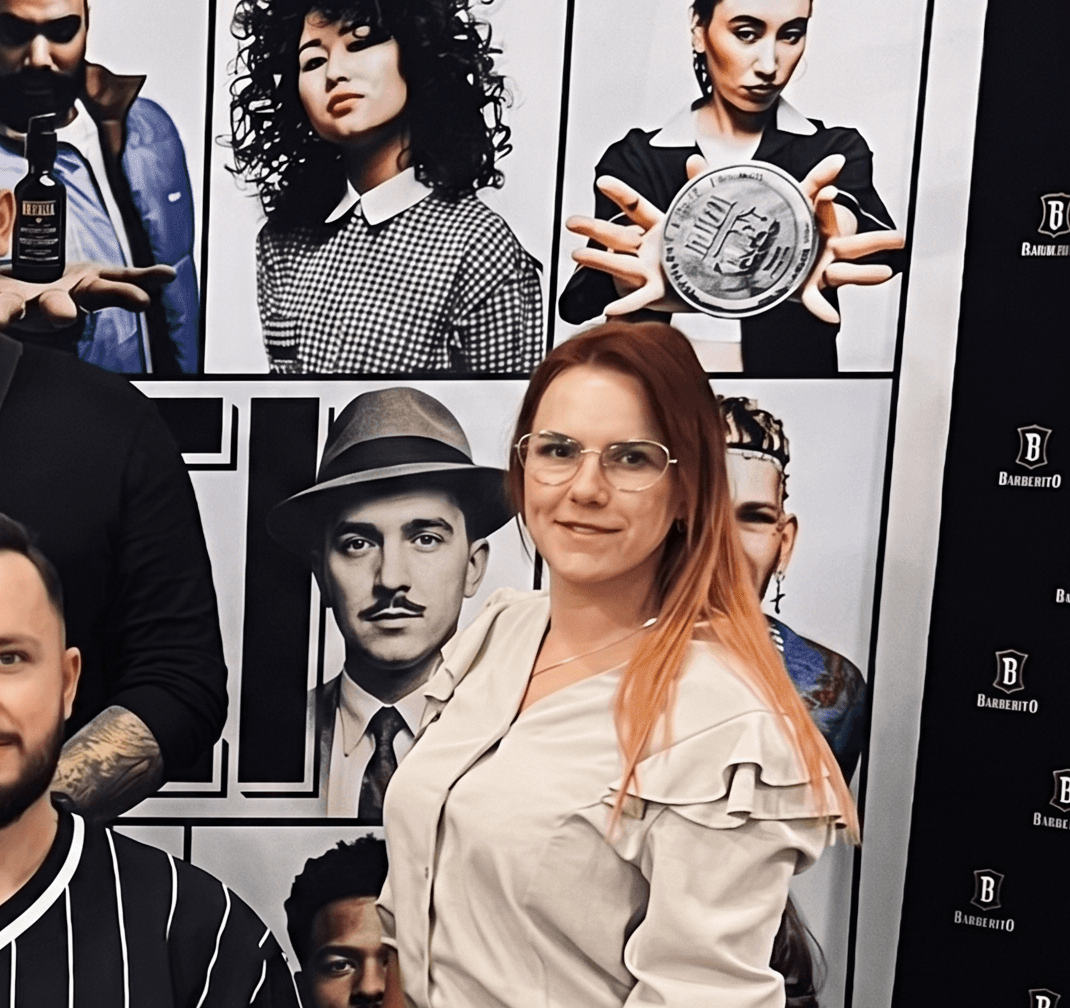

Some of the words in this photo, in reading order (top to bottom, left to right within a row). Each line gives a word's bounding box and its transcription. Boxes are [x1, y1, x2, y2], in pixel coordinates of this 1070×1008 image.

[1048, 200, 1064, 231] B
[1025, 433, 1041, 462] B
[1002, 657, 1018, 685] B
[1059, 776, 1070, 804] B
[980, 876, 995, 903] B
